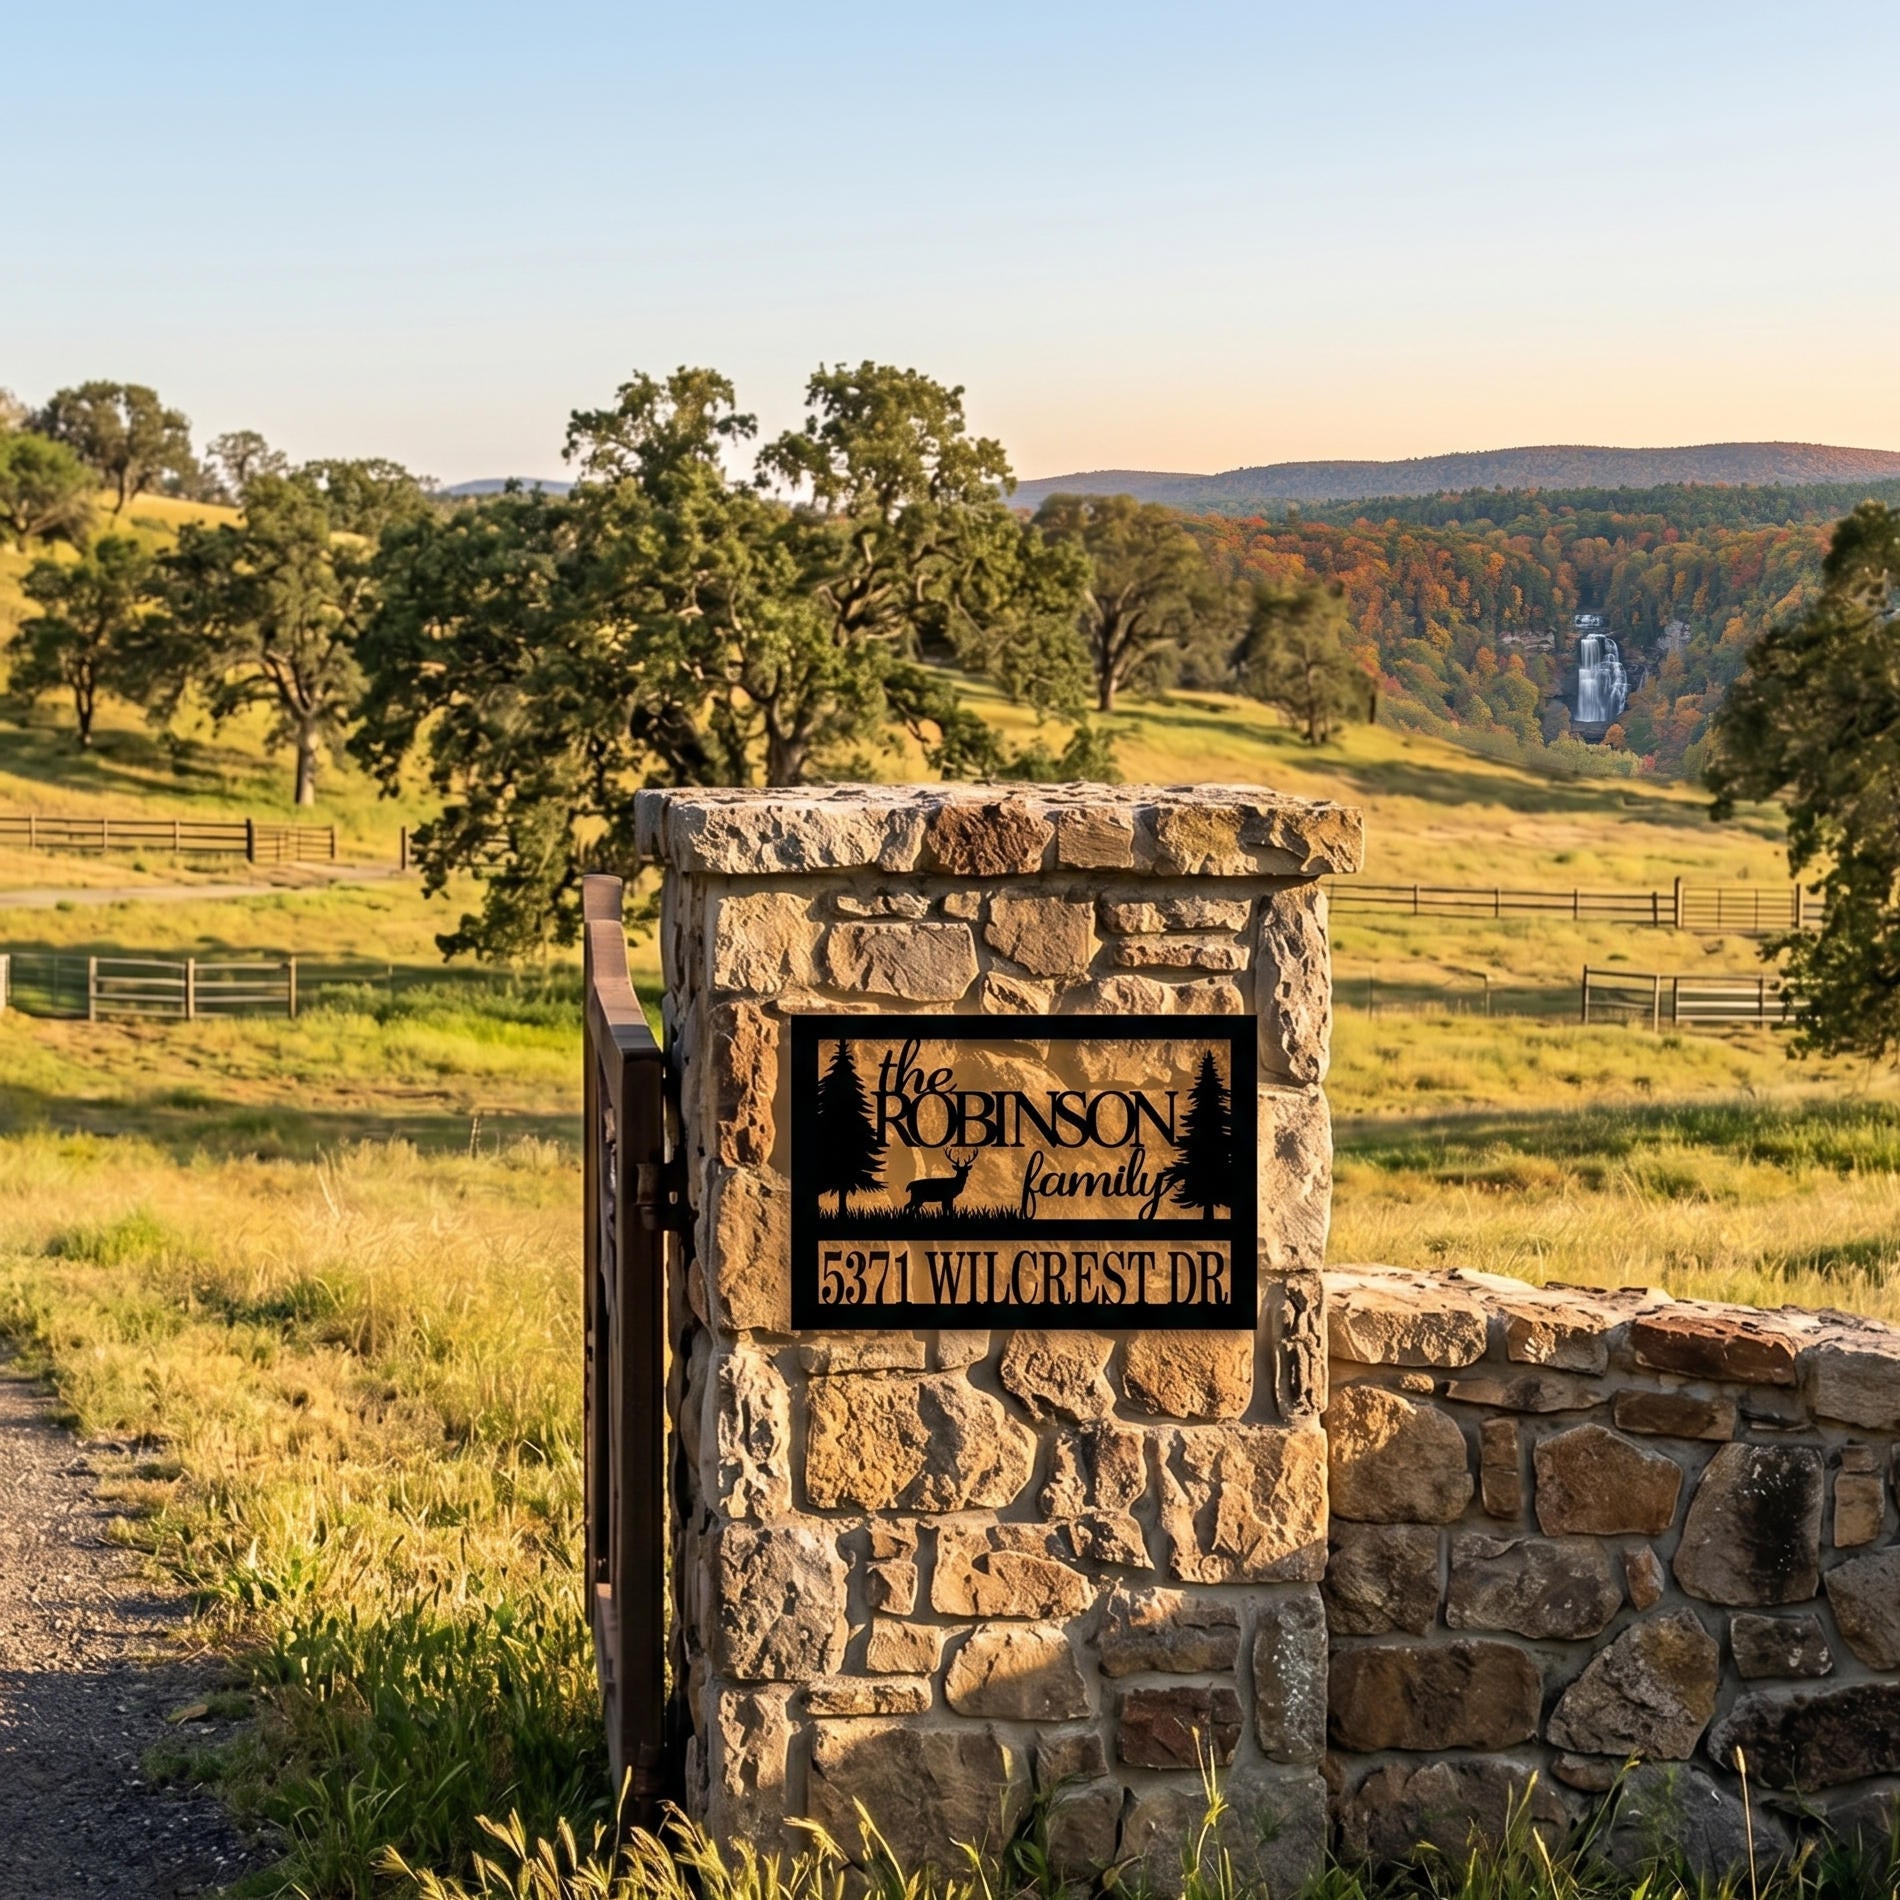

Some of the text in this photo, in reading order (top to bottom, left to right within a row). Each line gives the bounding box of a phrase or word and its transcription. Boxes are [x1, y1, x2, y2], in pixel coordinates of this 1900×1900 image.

[879, 1039, 957, 1094] the
[872, 1090, 1179, 1148] ROBINSON
[1021, 1148, 1174, 1220] family
[822, 1250, 1229, 1304] 5371 WILCREST DR
